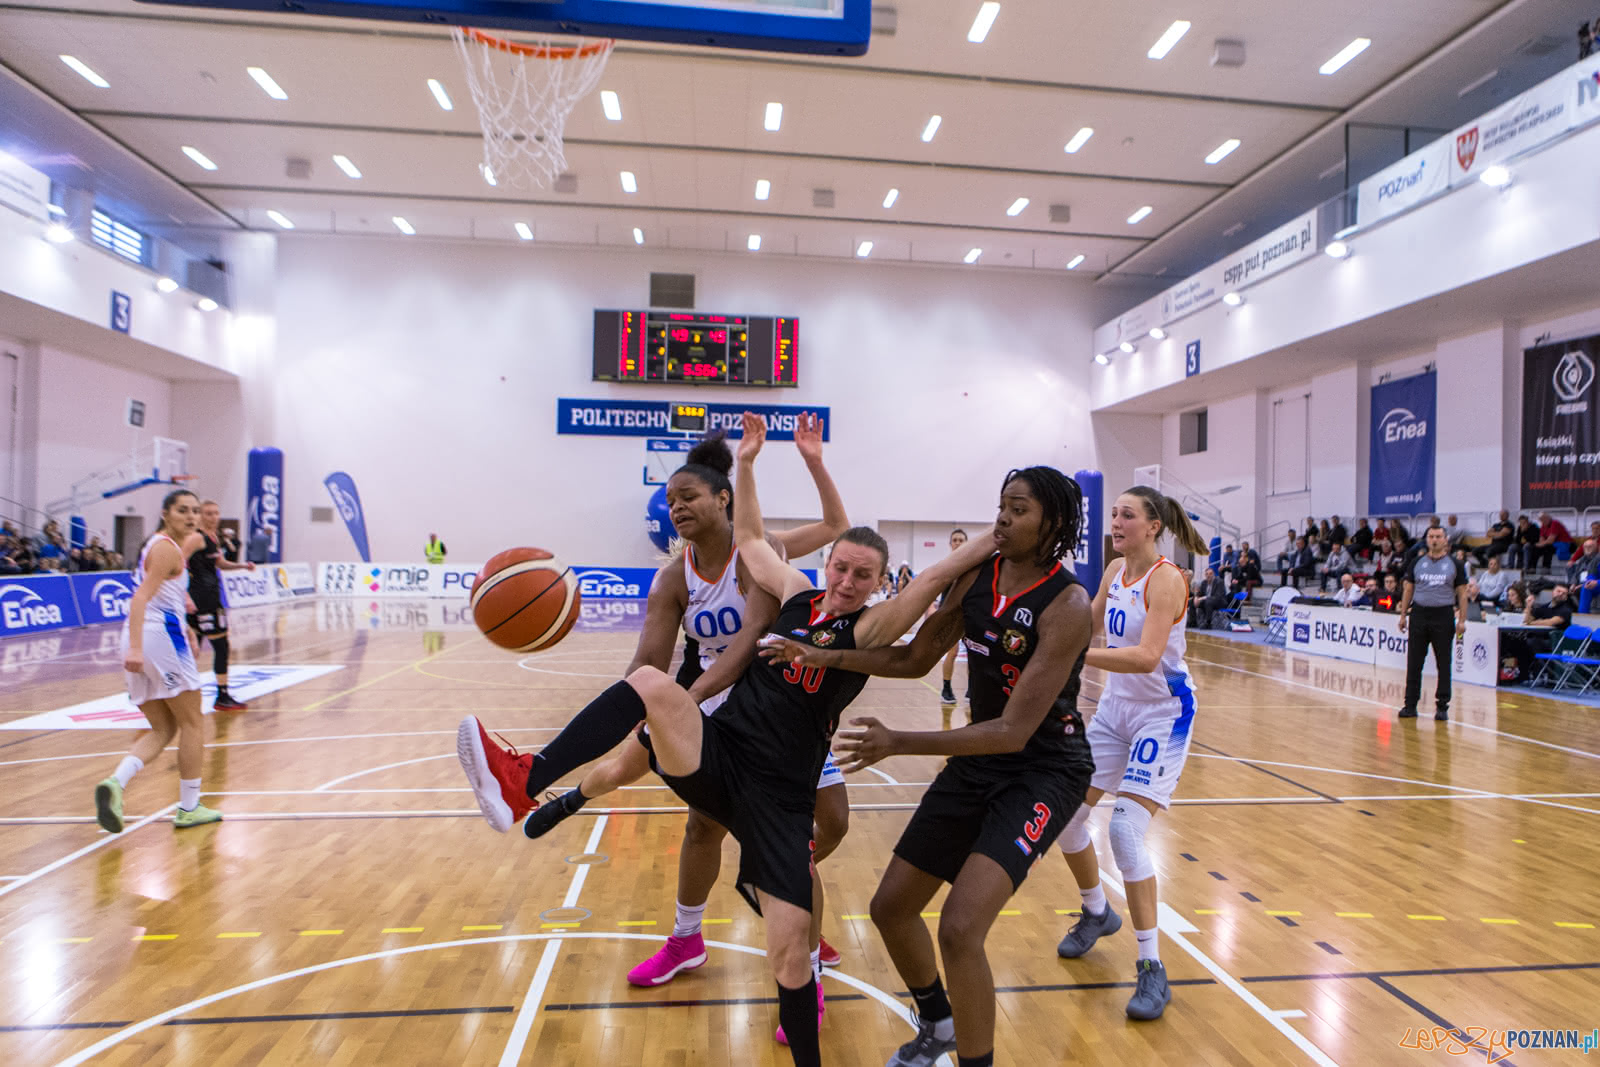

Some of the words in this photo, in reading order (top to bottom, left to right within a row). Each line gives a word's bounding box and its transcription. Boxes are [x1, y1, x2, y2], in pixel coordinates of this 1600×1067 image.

[115, 296, 129, 331] 3
[1188, 343, 1198, 372] 3
[571, 407, 709, 432] POLITECHN
[1385, 421, 1427, 443] Enea
[580, 579, 640, 596] Enea
[2, 600, 63, 629] Enea
[695, 606, 742, 638] 00
[1108, 607, 1127, 637] 10
[1315, 621, 1347, 644] ENEA
[1350, 625, 1375, 648] AZS
[1130, 738, 1159, 764] 10
[1024, 802, 1051, 842] 3
